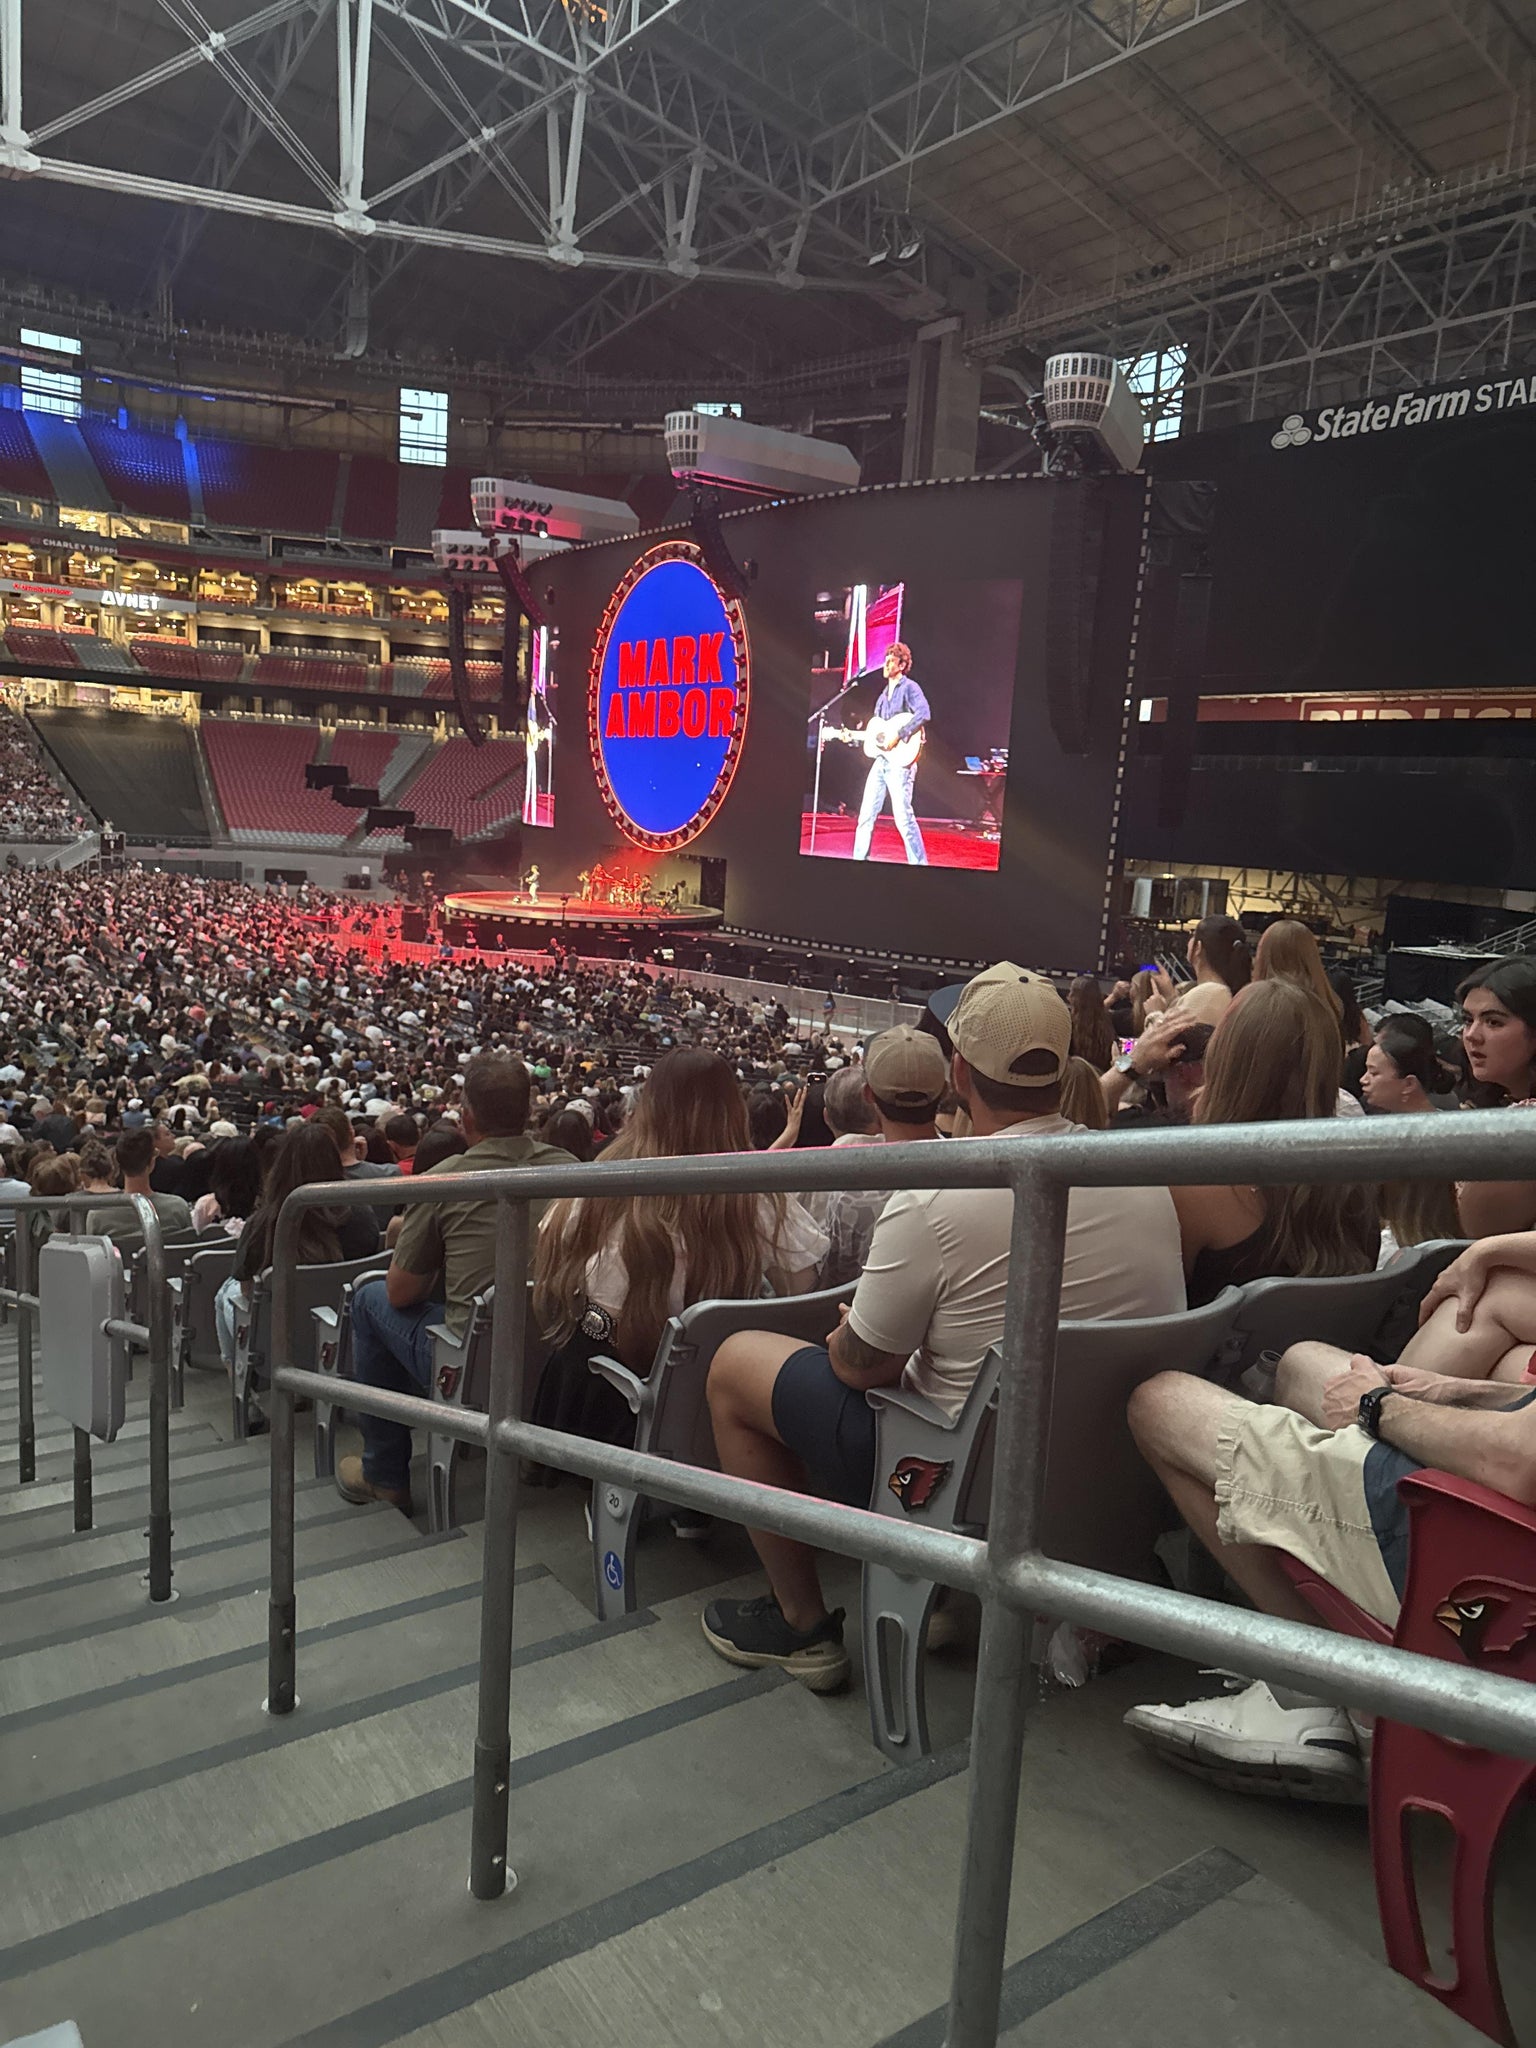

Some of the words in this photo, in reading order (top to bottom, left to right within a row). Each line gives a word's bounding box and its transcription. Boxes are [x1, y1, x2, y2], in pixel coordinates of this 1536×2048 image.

[1474, 376, 1536, 412] STA
[42, 538, 86, 551] CHARLEY
[88, 545, 118, 555] TRIPPI
[101, 590, 160, 610] AVNET
[618, 632, 725, 688] MARK
[604, 687, 735, 738] AMBOR
[609, 1494, 619, 1508] 20
